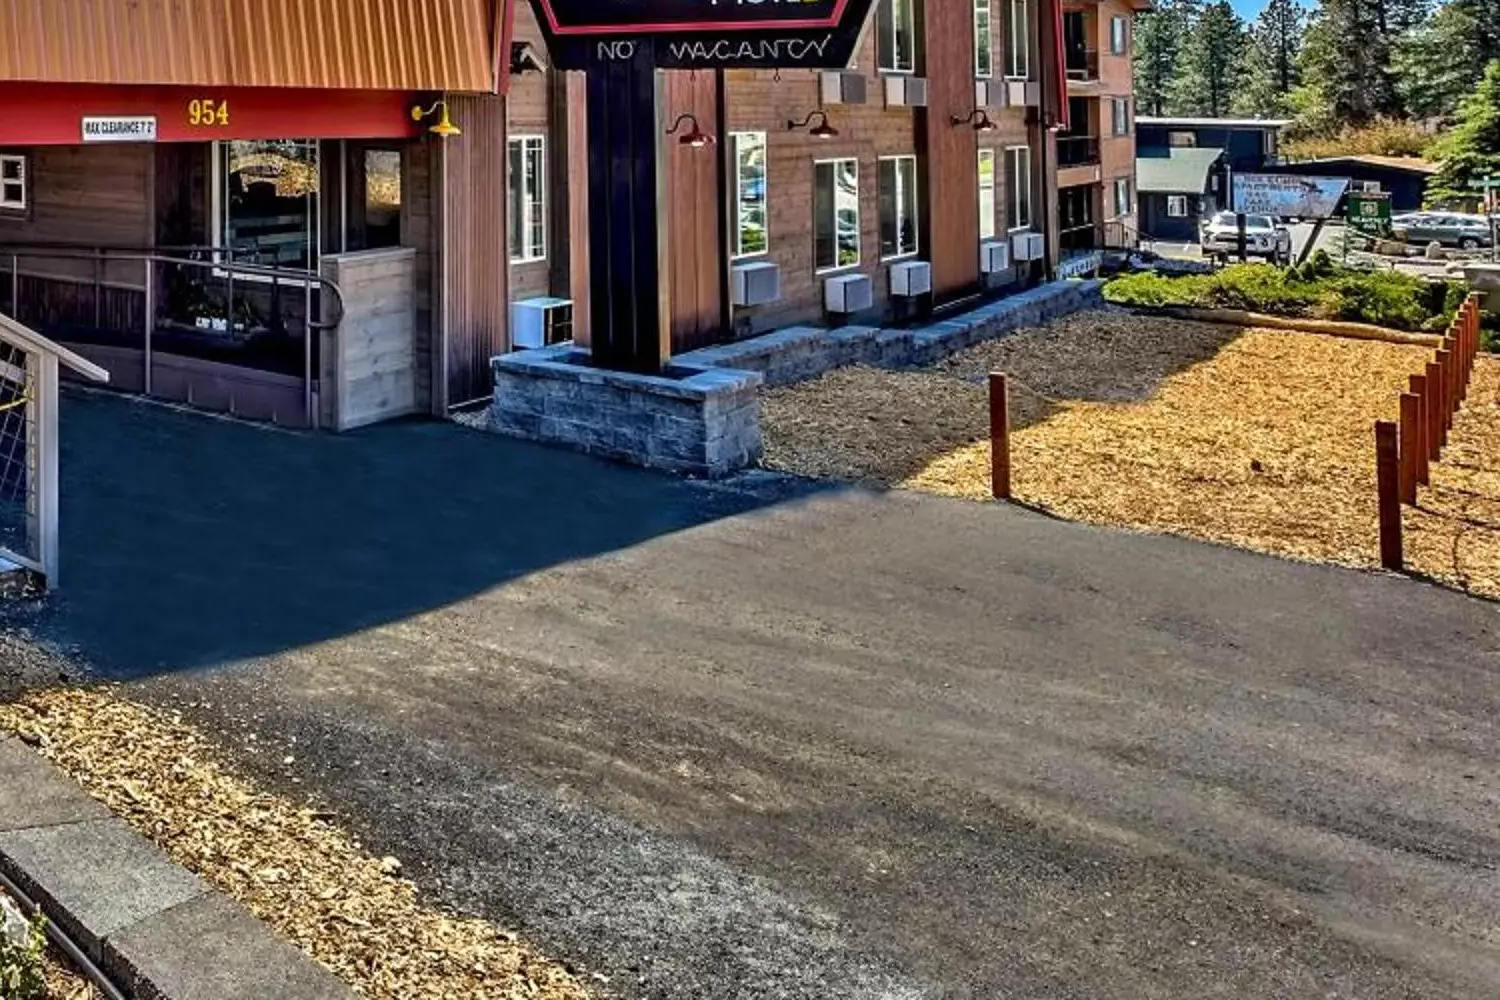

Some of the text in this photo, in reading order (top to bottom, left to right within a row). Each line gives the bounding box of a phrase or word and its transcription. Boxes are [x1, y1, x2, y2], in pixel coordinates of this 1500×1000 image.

[597, 33, 833, 60] NO VACANCY
[189, 100, 229, 125] 954
